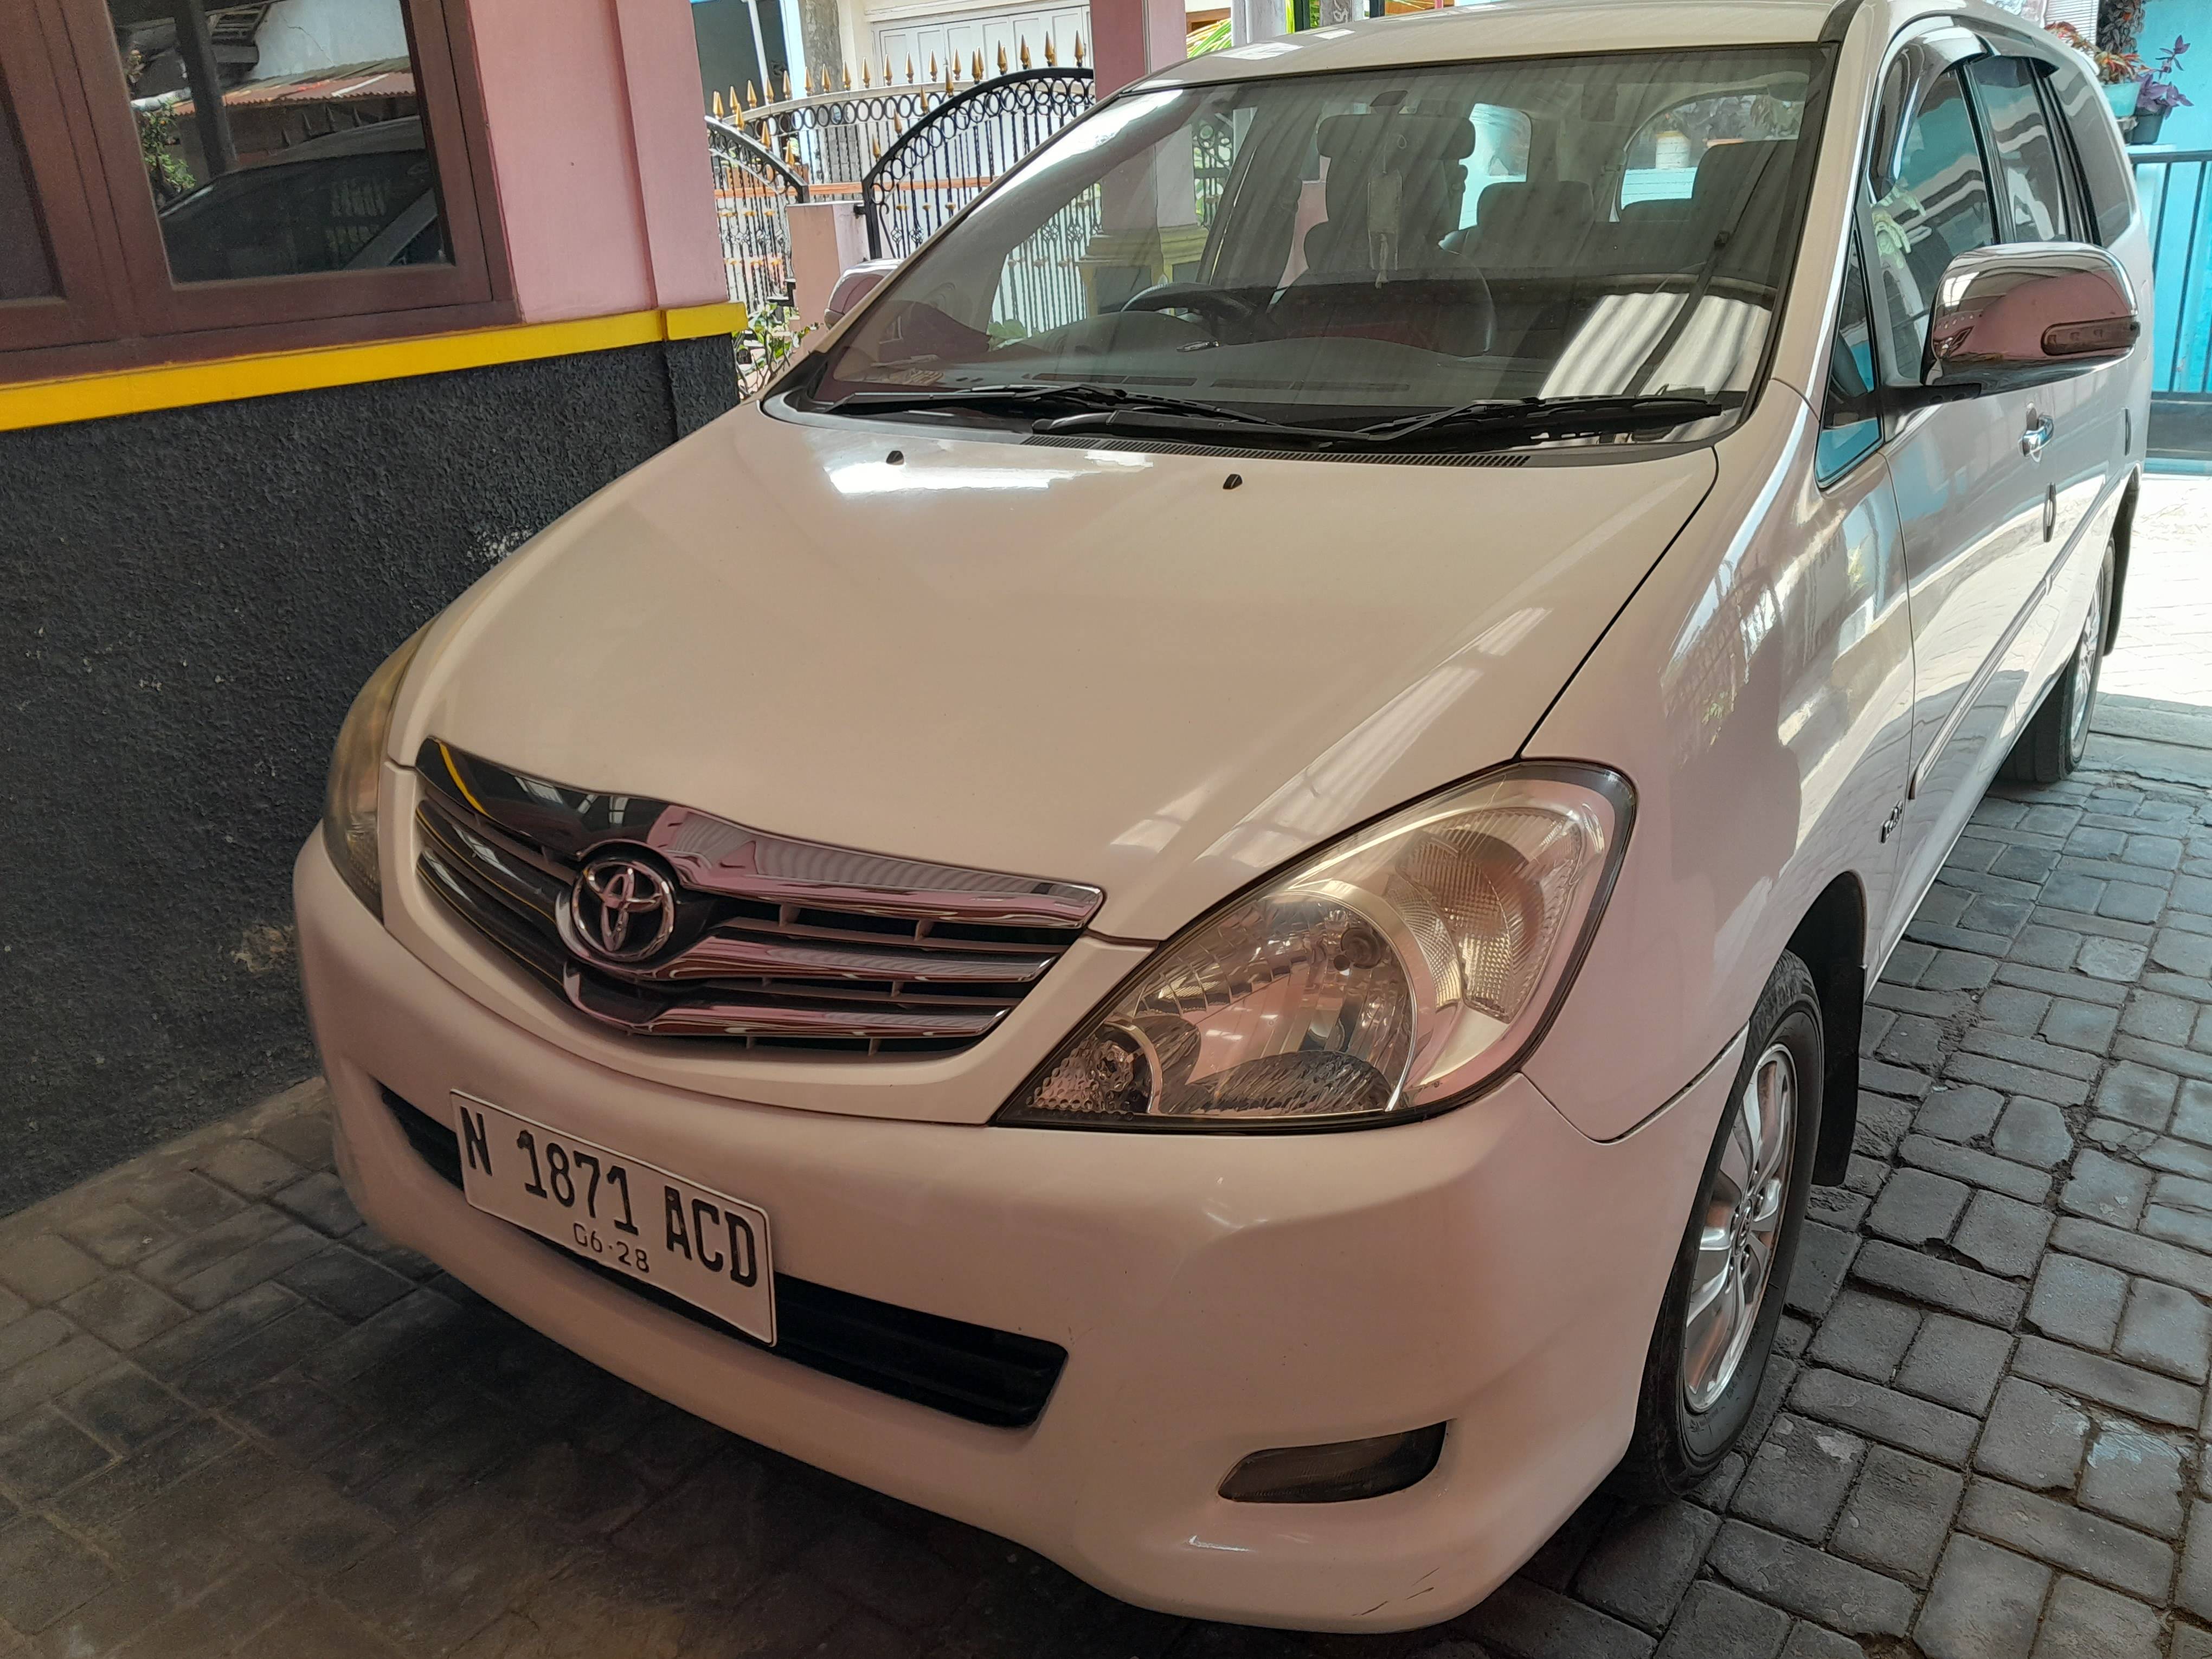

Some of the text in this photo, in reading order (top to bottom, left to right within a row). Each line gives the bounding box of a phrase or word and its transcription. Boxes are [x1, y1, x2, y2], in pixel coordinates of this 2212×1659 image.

[460, 1106, 757, 1288] N 1871 ACD
